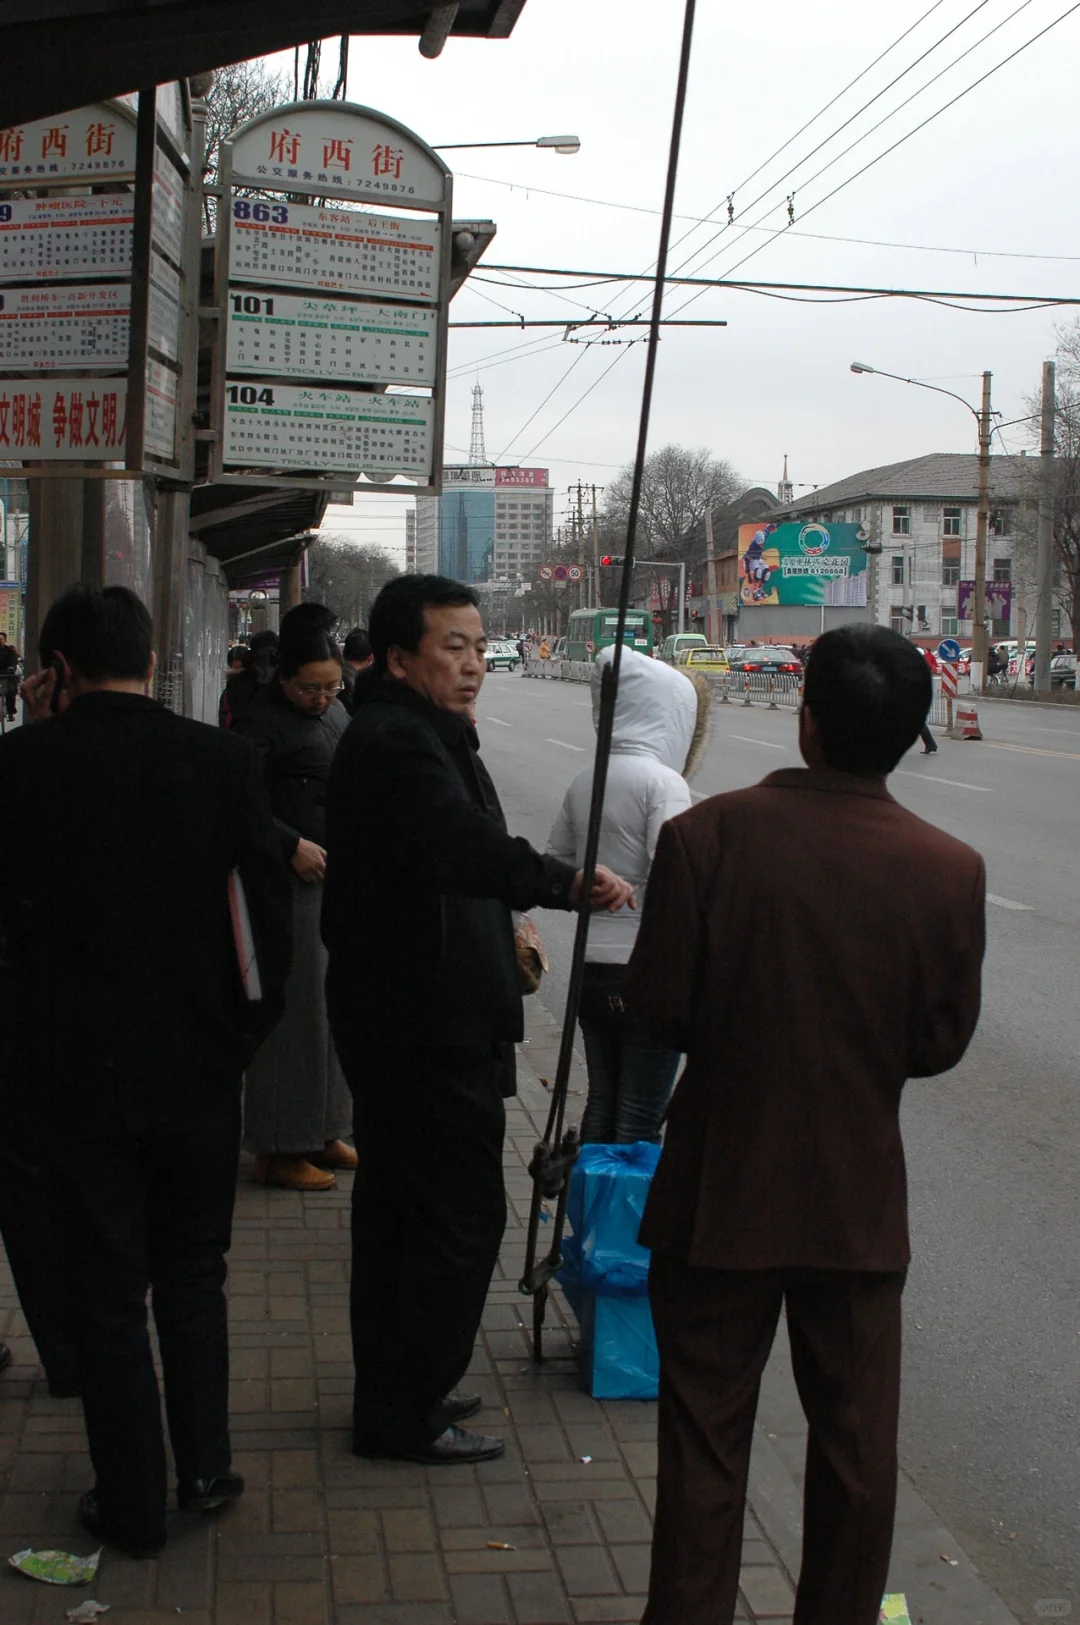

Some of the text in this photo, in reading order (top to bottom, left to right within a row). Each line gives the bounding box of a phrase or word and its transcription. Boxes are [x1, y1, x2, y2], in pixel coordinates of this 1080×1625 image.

[0, 122, 116, 162] 府西街
[268, 128, 405, 179] 府西街
[233, 201, 288, 224] 863
[230, 293, 274, 316] 101
[284, 367, 379, 379] TROLLY BUS
[226, 385, 275, 406] 104
[280, 458, 330, 467] TROLLY
[571, 569, 579, 577] 50
